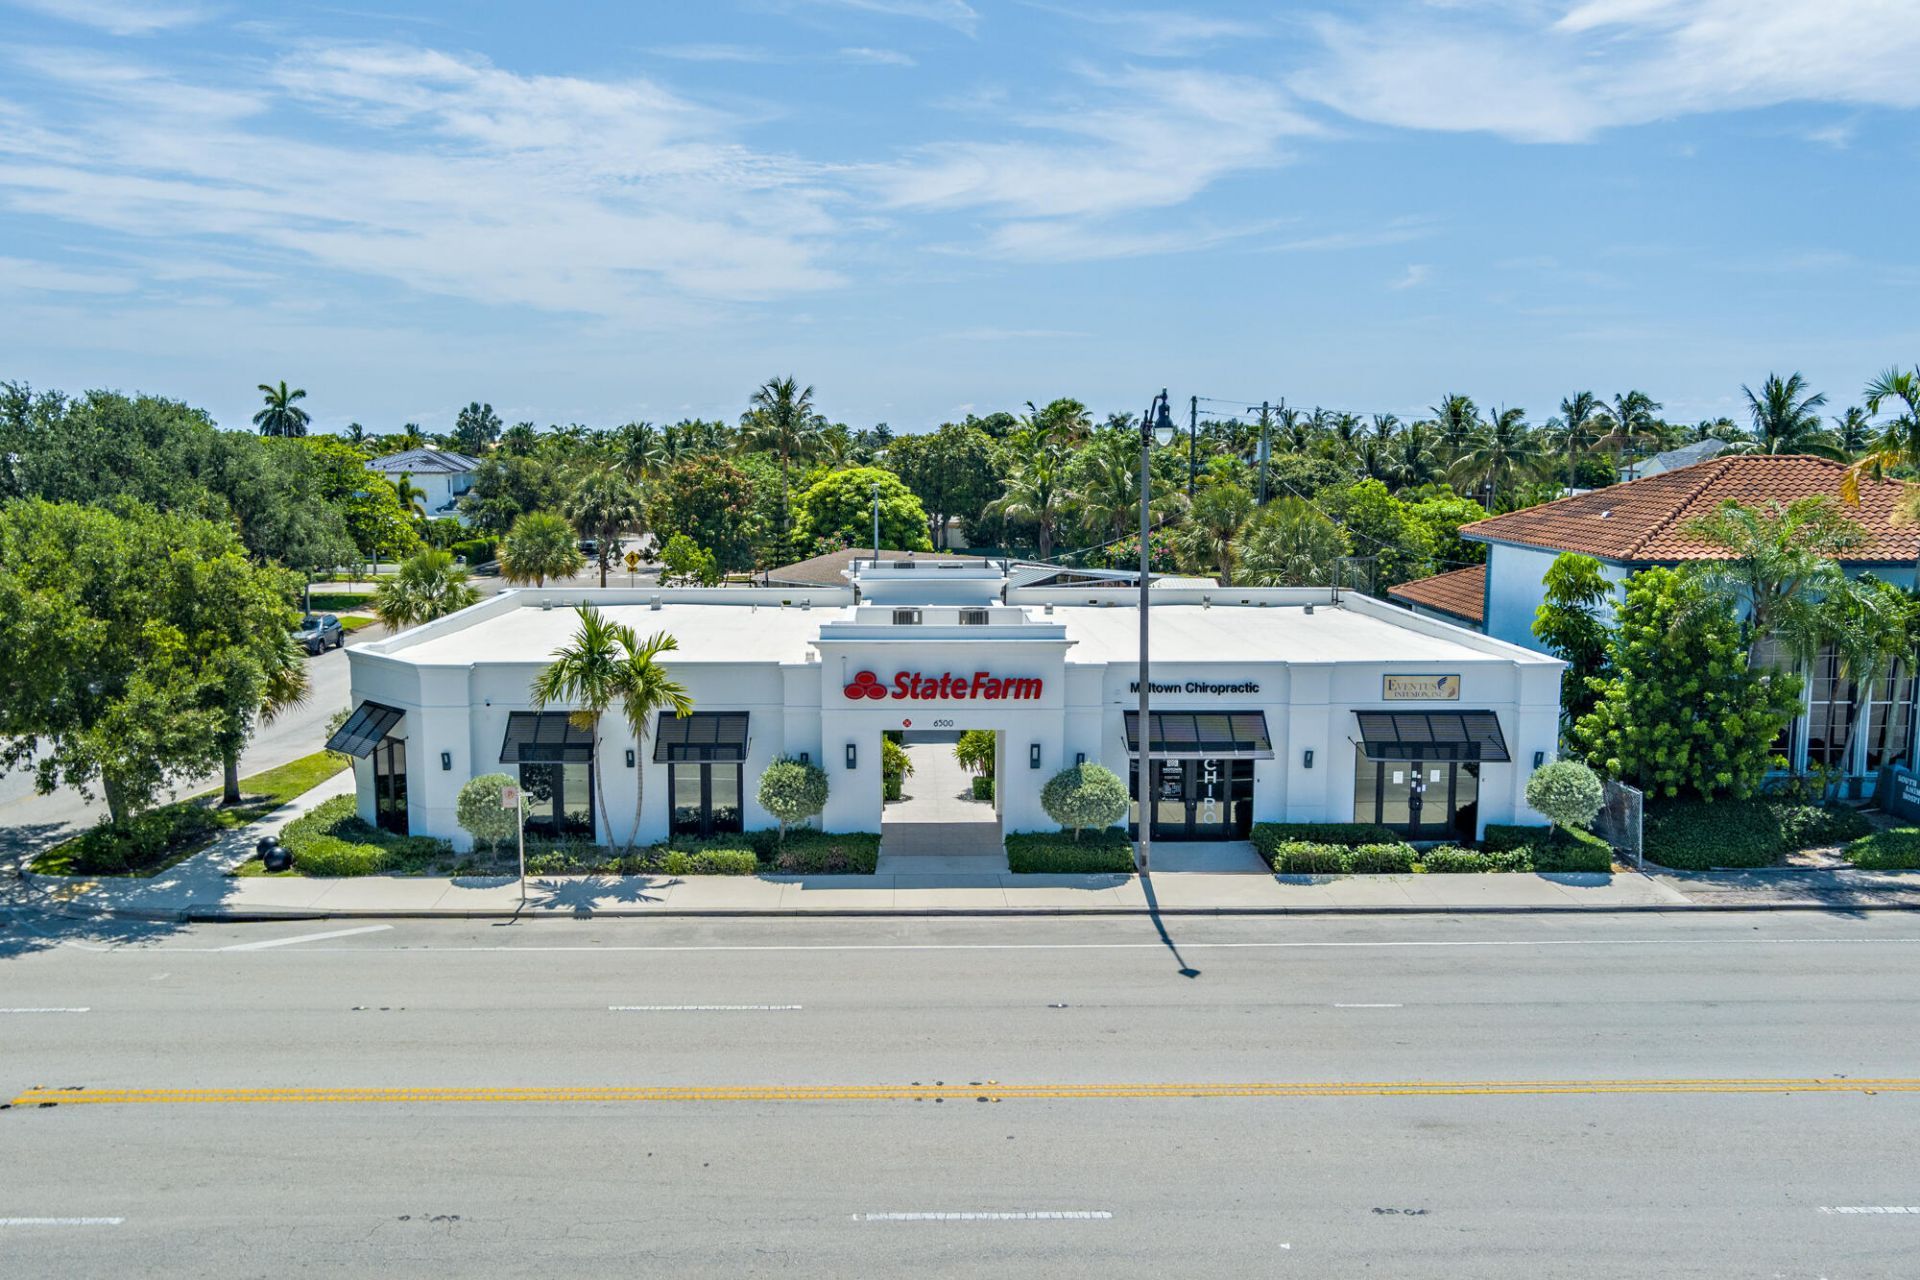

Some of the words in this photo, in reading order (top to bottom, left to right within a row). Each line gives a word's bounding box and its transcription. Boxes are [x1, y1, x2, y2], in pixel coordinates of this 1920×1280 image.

[1185, 682, 1260, 695] Chiropractic
[933, 719, 954, 728] 6500
[1203, 759, 1217, 824] CHIRO
